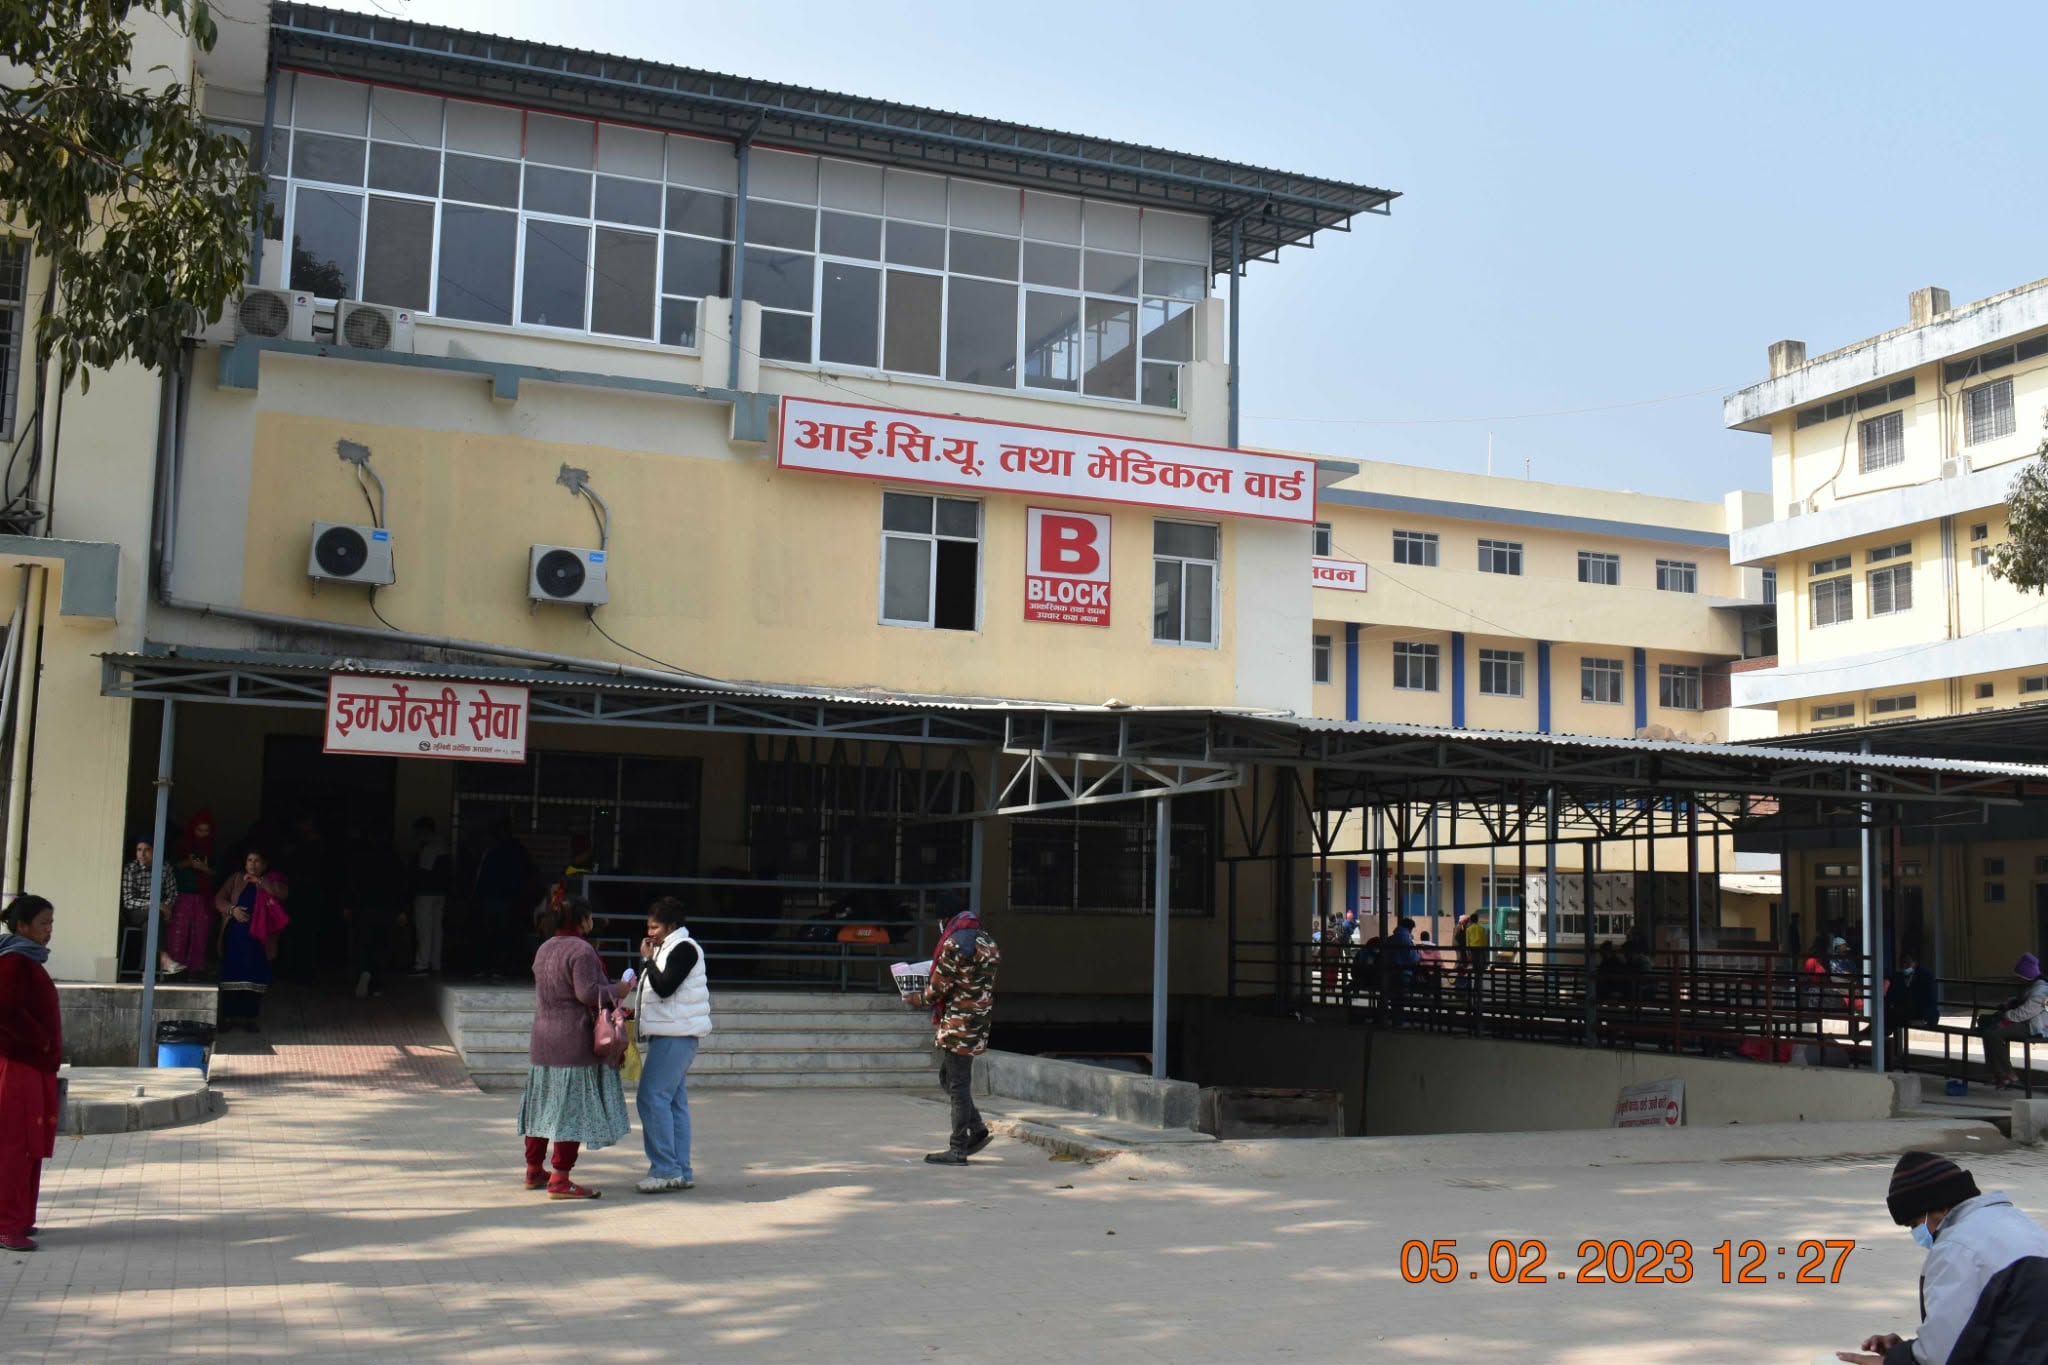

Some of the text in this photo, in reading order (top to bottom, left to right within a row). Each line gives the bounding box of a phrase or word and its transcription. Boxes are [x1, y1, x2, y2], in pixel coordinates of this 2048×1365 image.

[999, 444, 1076, 477] तथा
[1087, 446, 1233, 494] मेडिकल
[1244, 470, 1306, 501] वार्ड
[1041, 514, 1100, 575] B
[1028, 579, 1109, 606] BLOCK
[336, 683, 522, 741] इमर्जेन्सी सेवा
